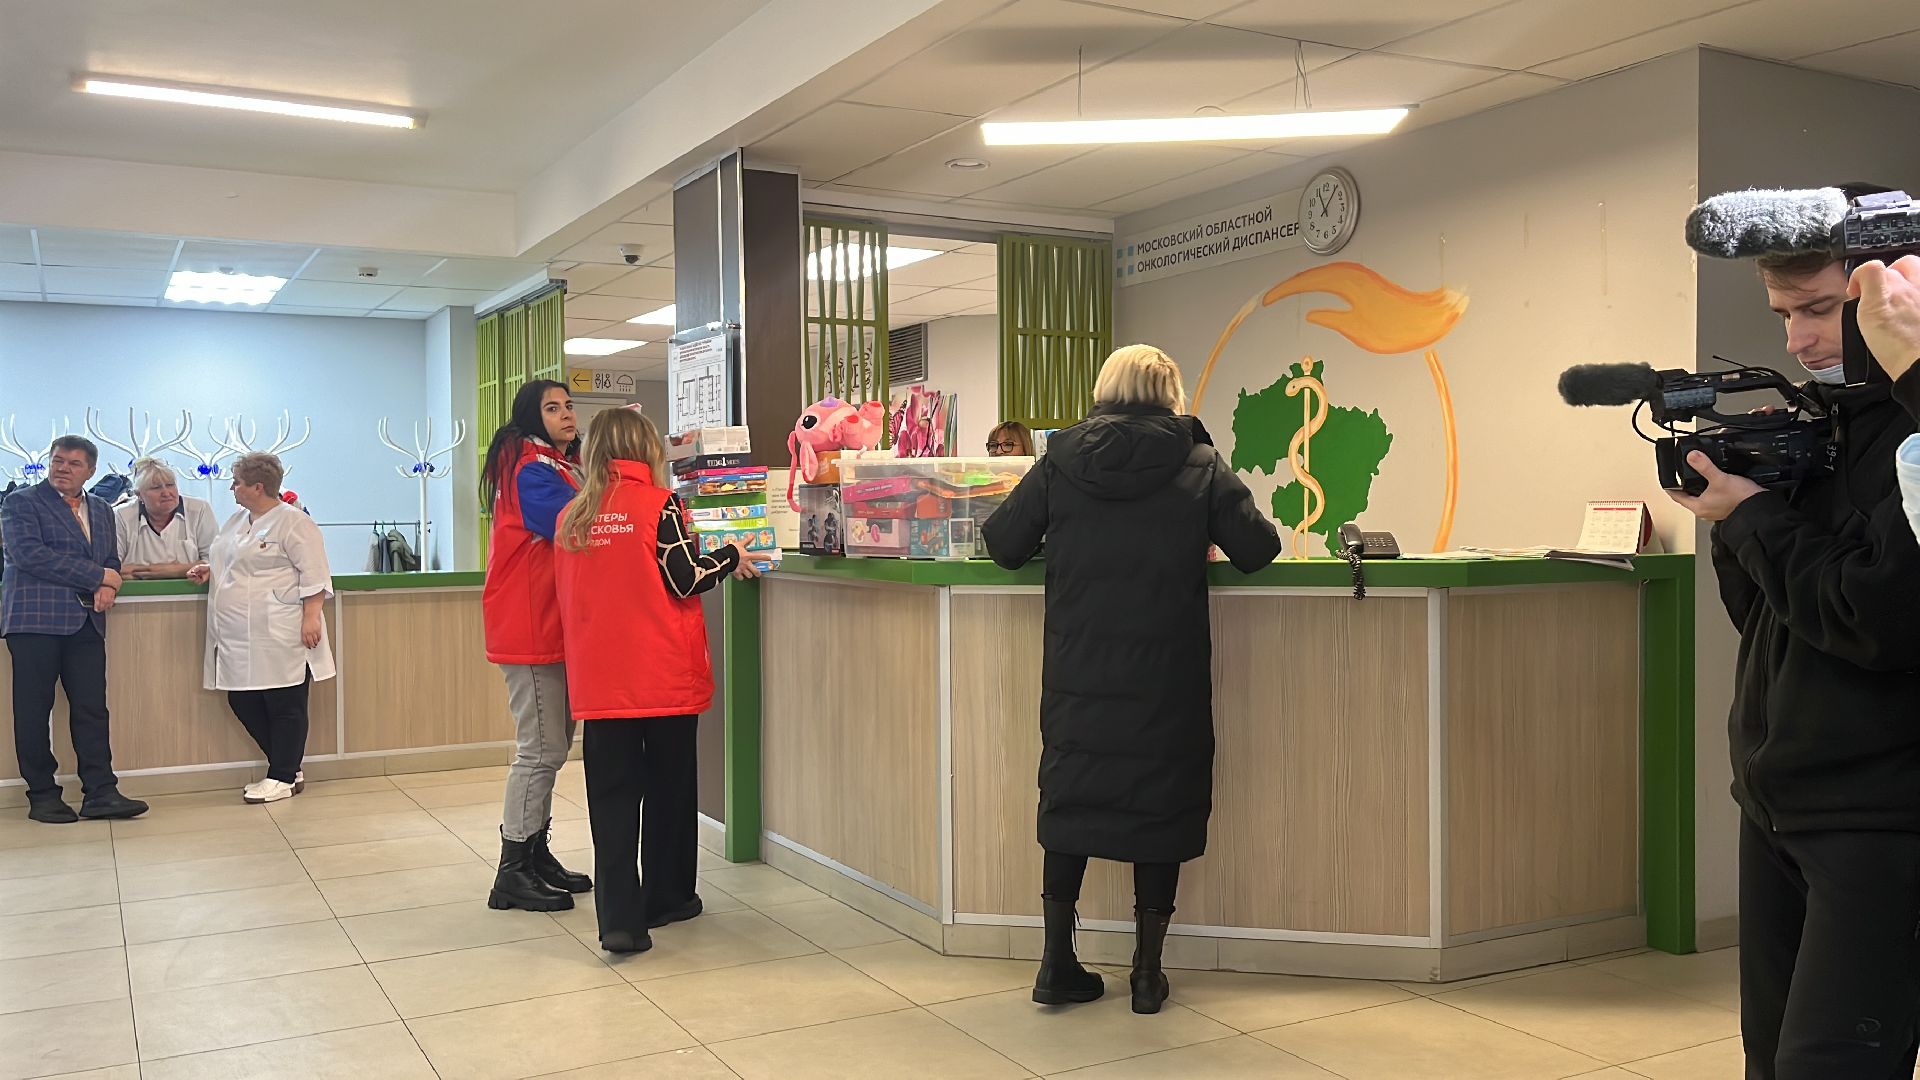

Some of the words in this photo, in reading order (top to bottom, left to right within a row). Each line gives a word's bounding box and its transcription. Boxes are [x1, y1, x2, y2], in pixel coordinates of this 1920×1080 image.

[1137, 226, 1203, 256] МОСКОВСКИЙ
[1205, 205, 1273, 240] ОБЛАСТНОЙ
[1137, 239, 1230, 273] ОНКОЛОГИЧЕСКИЙ
[1232, 221, 1299, 252] ДИСПАНСЕР
[590, 523, 634, 535] СКОВЬЯ
